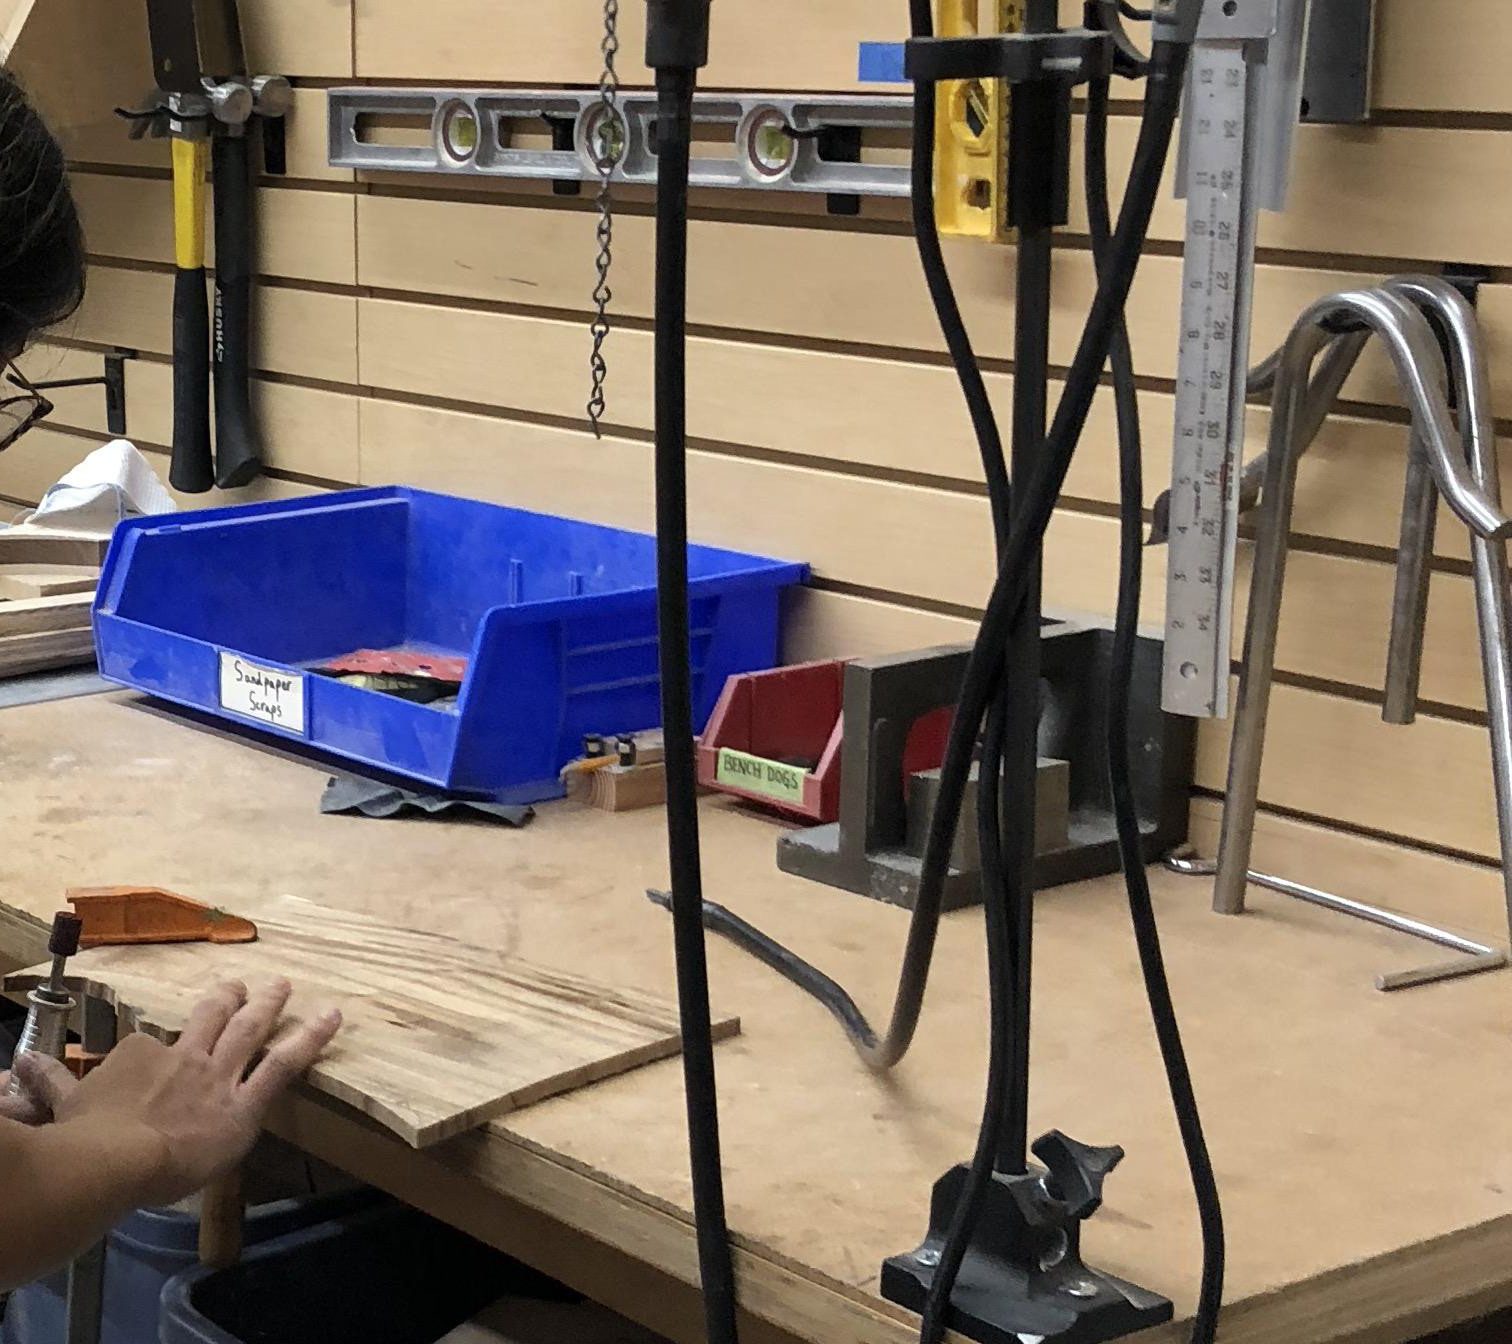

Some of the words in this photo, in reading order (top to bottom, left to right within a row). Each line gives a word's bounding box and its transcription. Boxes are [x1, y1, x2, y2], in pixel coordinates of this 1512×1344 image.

[215, 285, 224, 342] HUSKY
[234, 659, 292, 702] Sandpaper
[249, 690, 282, 722] Scraps
[723, 754, 762, 780] BENCH
[767, 765, 799, 790] DOGS
